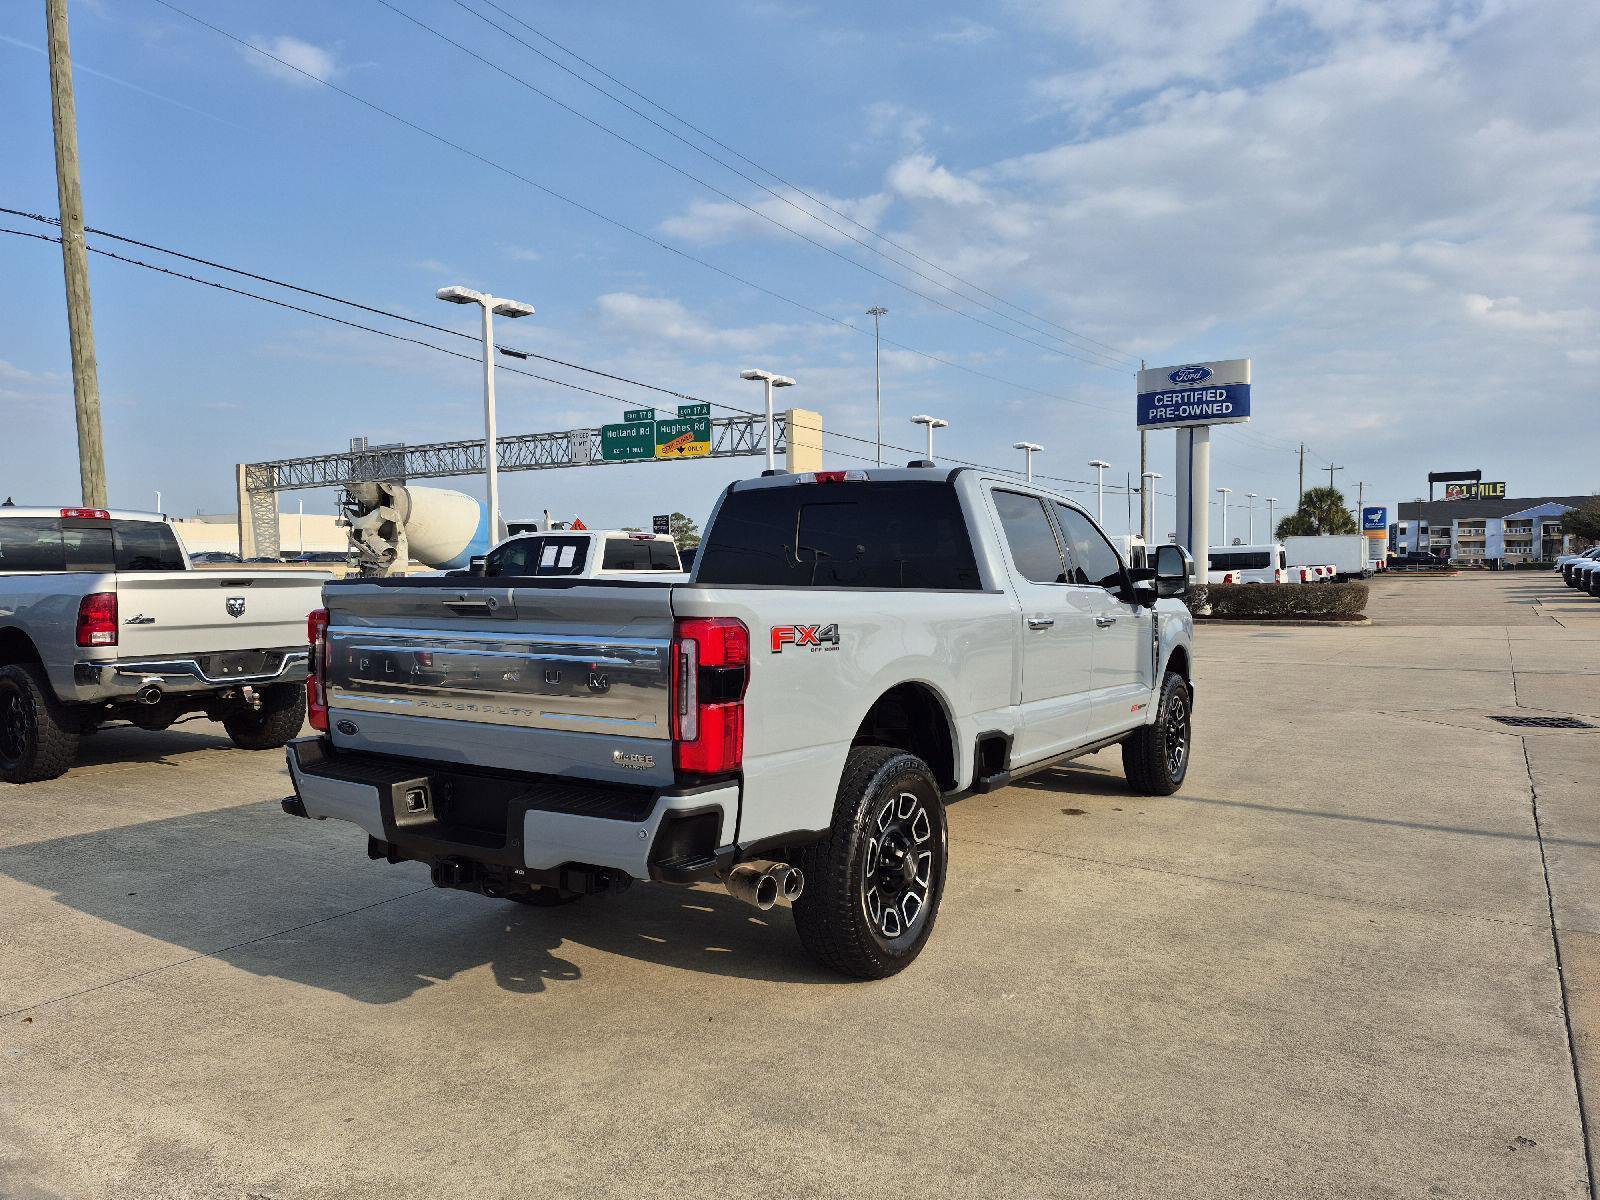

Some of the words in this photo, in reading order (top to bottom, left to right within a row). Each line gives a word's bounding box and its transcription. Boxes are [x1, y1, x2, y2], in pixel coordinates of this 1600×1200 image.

[1176, 369, 1202, 381] Ford
[1154, 389, 1227, 406] CERTIFIED
[1148, 402, 1233, 420] PRE-OWNED
[607, 428, 637, 438] Holland
[640, 427, 650, 436] Rd
[660, 424, 691, 435] Hughes
[694, 422, 705, 431] Rd
[1471, 483, 1505, 497] MILE
[770, 623, 840, 654] FX4
[359, 658, 609, 688] PLATINUM
